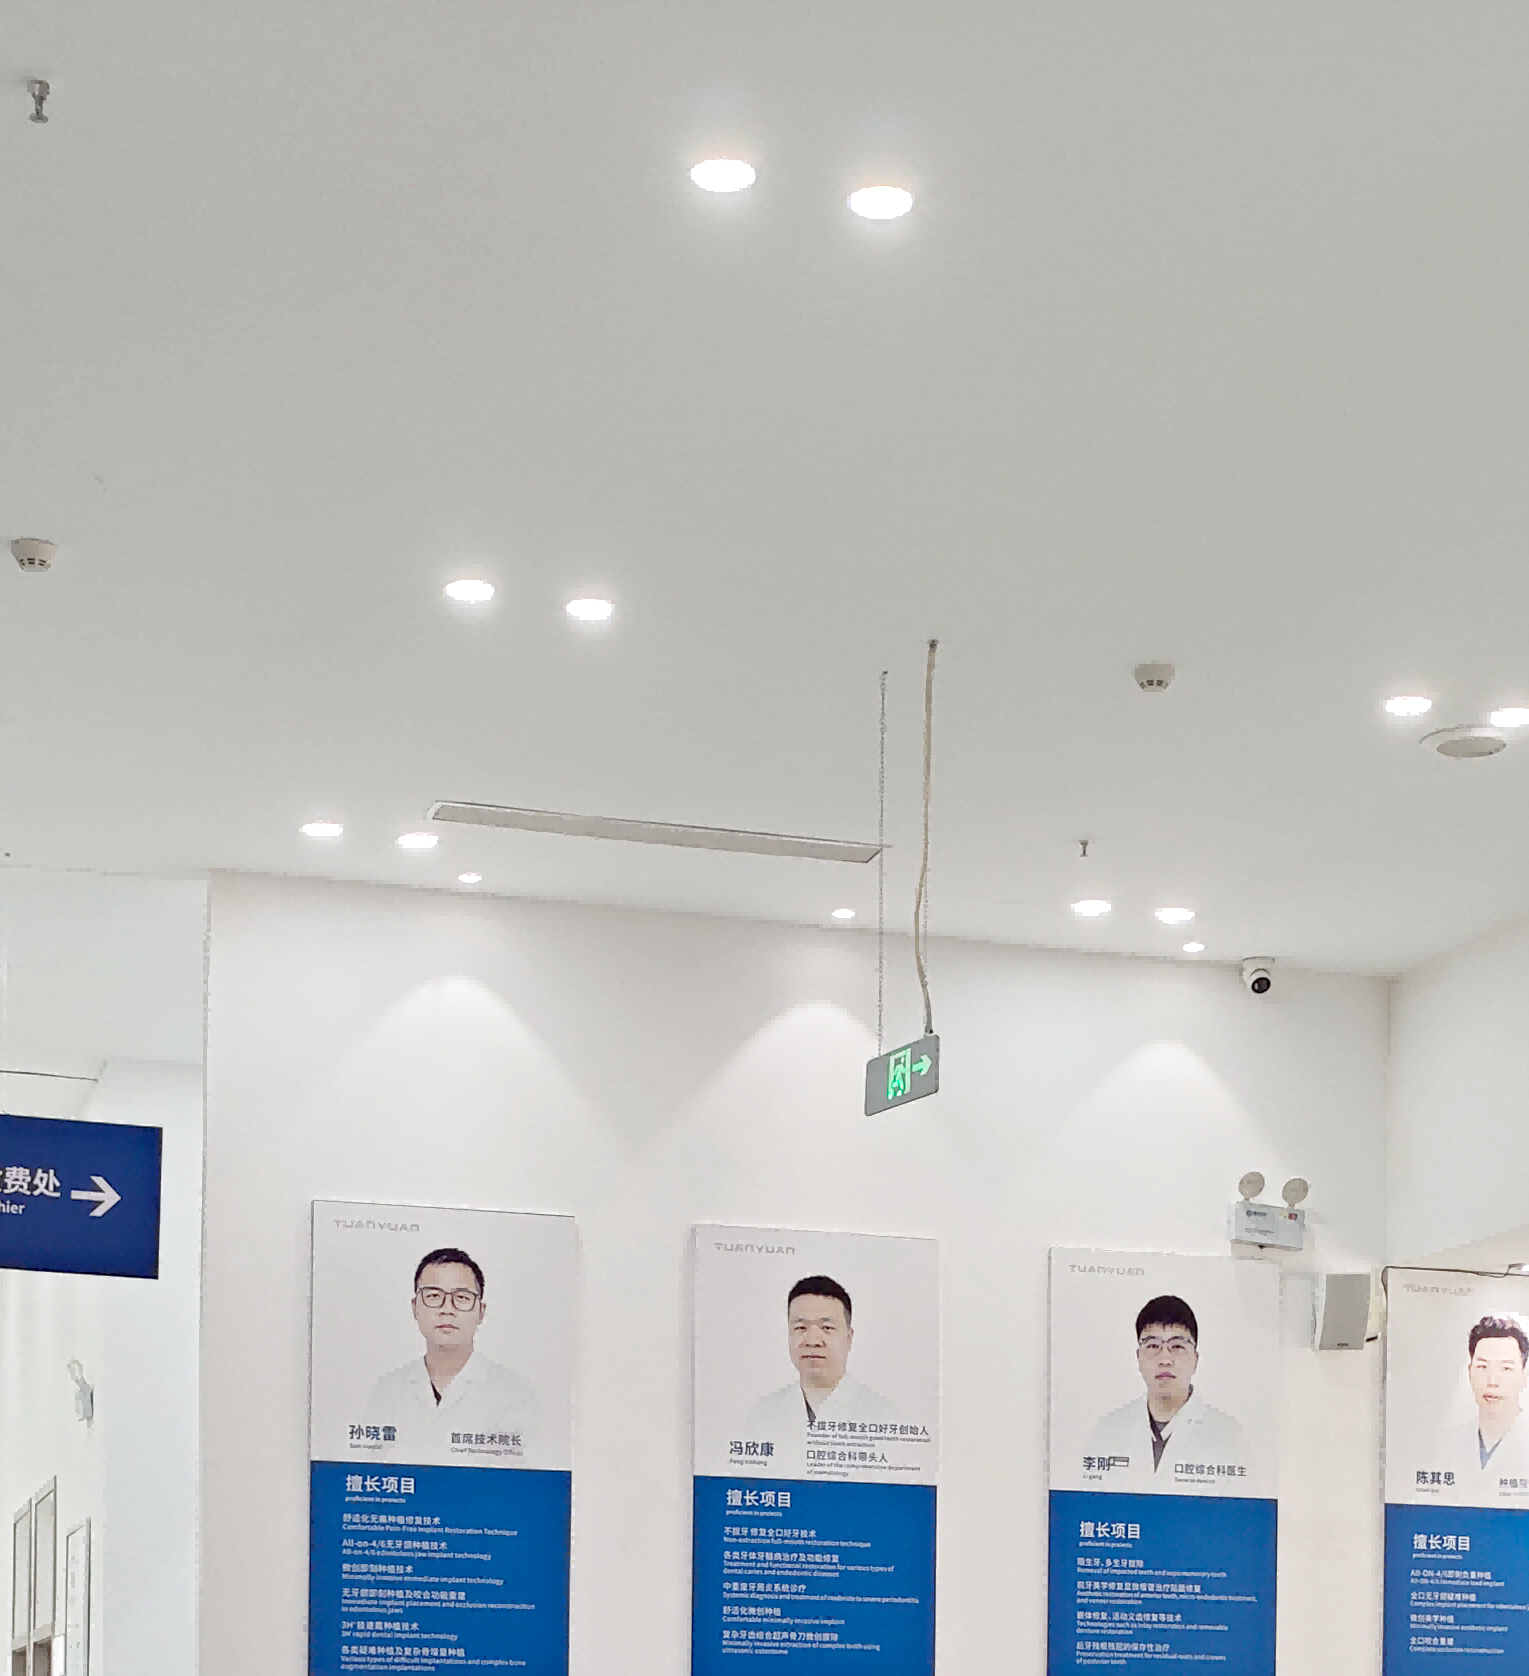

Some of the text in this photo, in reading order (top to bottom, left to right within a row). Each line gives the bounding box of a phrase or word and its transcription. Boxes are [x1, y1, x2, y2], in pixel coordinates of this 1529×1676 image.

[349, 1425, 396, 1441] 孙晓雷
[807, 1419, 929, 1435] 不拔牙修复全口好牙创始人
[451, 1432, 521, 1446] 首席技术院长
[730, 1441, 774, 1456] 冯欣康
[807, 1450, 888, 1462] 口腔综合科带头人
[1083, 1456, 1111, 1471] 李刚
[1174, 1463, 1247, 1477] 口腔综合科医生
[346, 1474, 415, 1494] 擅长项目
[726, 1489, 791, 1508] 擅长项目
[1080, 1521, 1140, 1539] 擅长项目
[1413, 1534, 1470, 1551] 擅长项目
